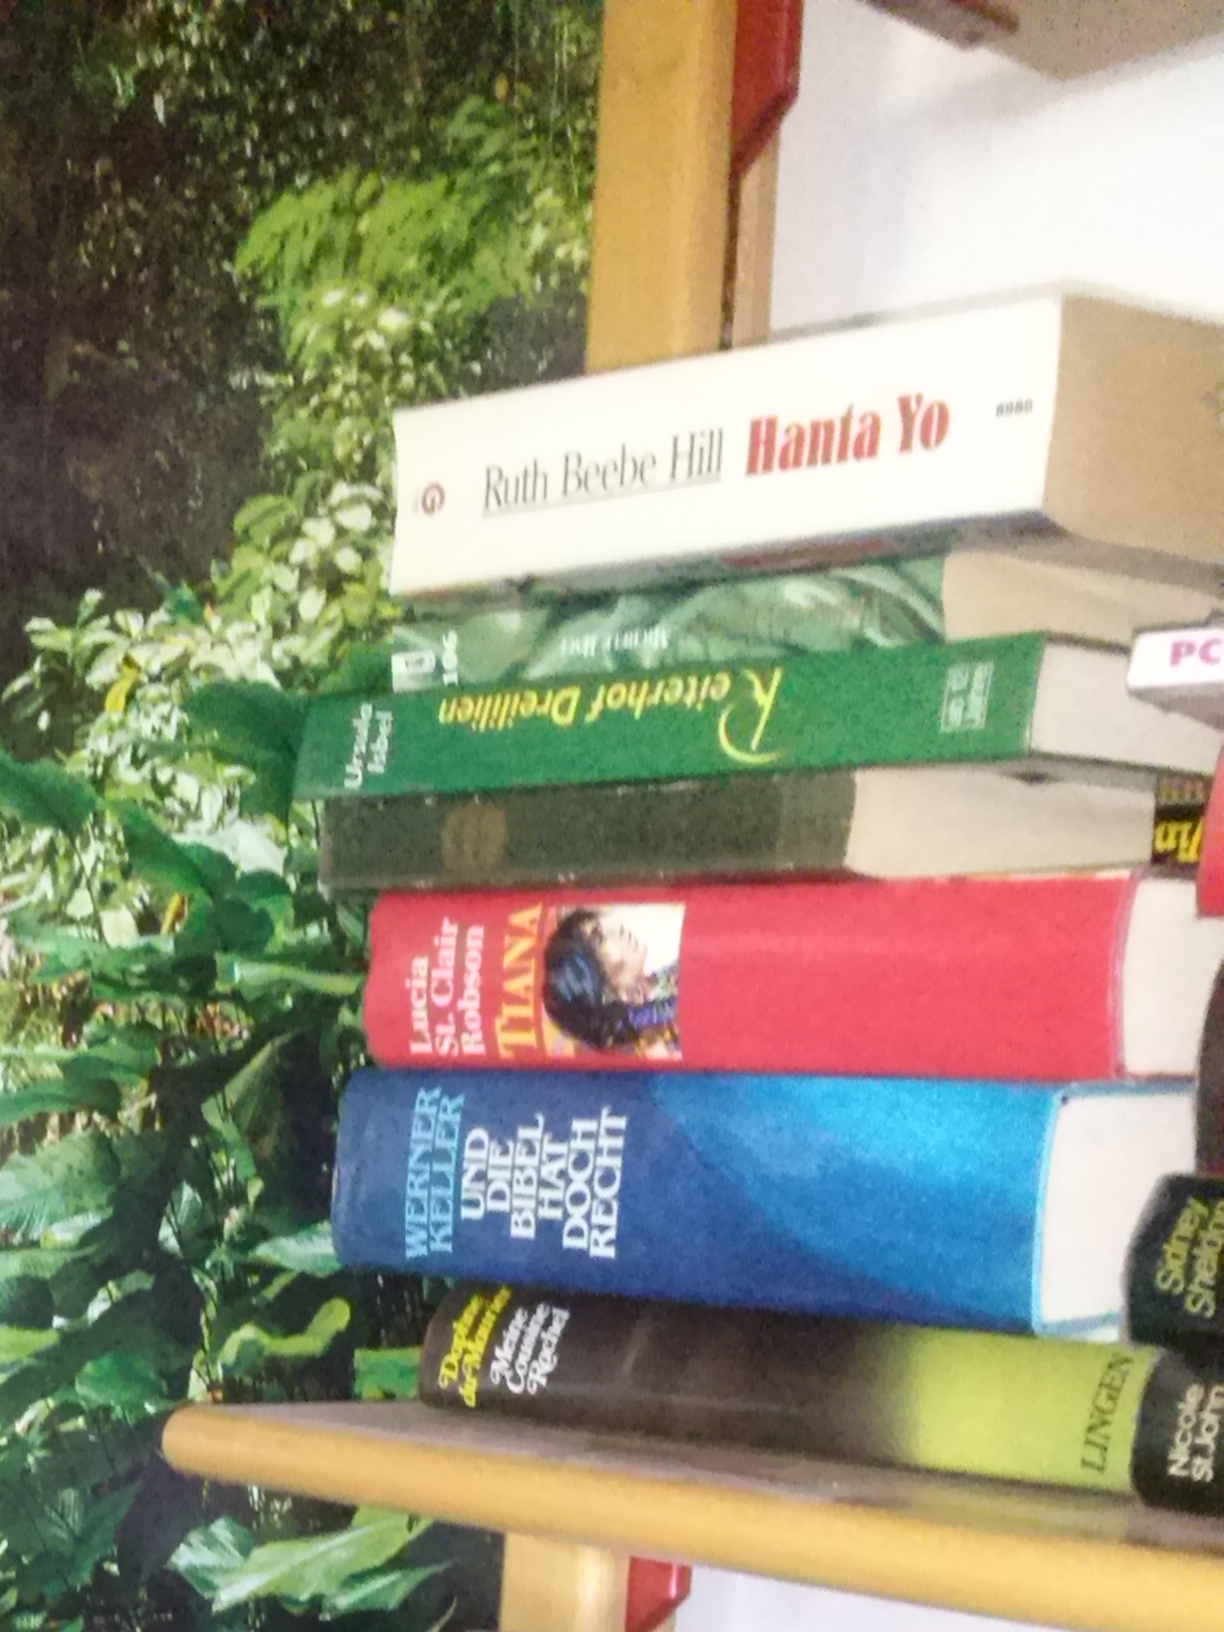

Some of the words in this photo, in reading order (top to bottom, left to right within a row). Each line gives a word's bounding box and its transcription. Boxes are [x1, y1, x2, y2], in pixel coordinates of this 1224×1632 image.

[483, 457, 549, 509] Ruth
[561, 443, 657, 498] Beebe
[670, 426, 724, 481] Hill
[745, 402, 882, 477] Hanta
[897, 393, 951, 453] Yo
[343, 702, 373, 790] Ursula
[367, 709, 394, 775] Isbel
[438, 685, 582, 733] Dreililien
[405, 955, 433, 1056] Lucia
[429, 915, 459, 1009] Clair
[457, 924, 486, 1056] Robson
[433, 1014, 459, 1057] St.
[405, 1086, 443, 1260] WERNER
[429, 1092, 465, 1253] KELLER
[460, 1126, 490, 1221] UND
[486, 1138, 514, 1214] DIE
[510, 1111, 545, 1240] BIBEL
[537, 1133, 569, 1221] HAT
[562, 1117, 599, 1251] DOCH
[589, 1105, 628, 1260] RECHT
[1155, 1195, 1210, 1298] Sidney
[438, 1293, 484, 1390] Daphne
[462, 1284, 513, 1380] Maurier
[489, 1306, 528, 1386] Meine
[506, 1302, 552, 1395] Cousine
[526, 1304, 571, 1397] Rachel
[1080, 1352, 1136, 1475] LINGEN
[1167, 1381, 1207, 1478] Nicole
